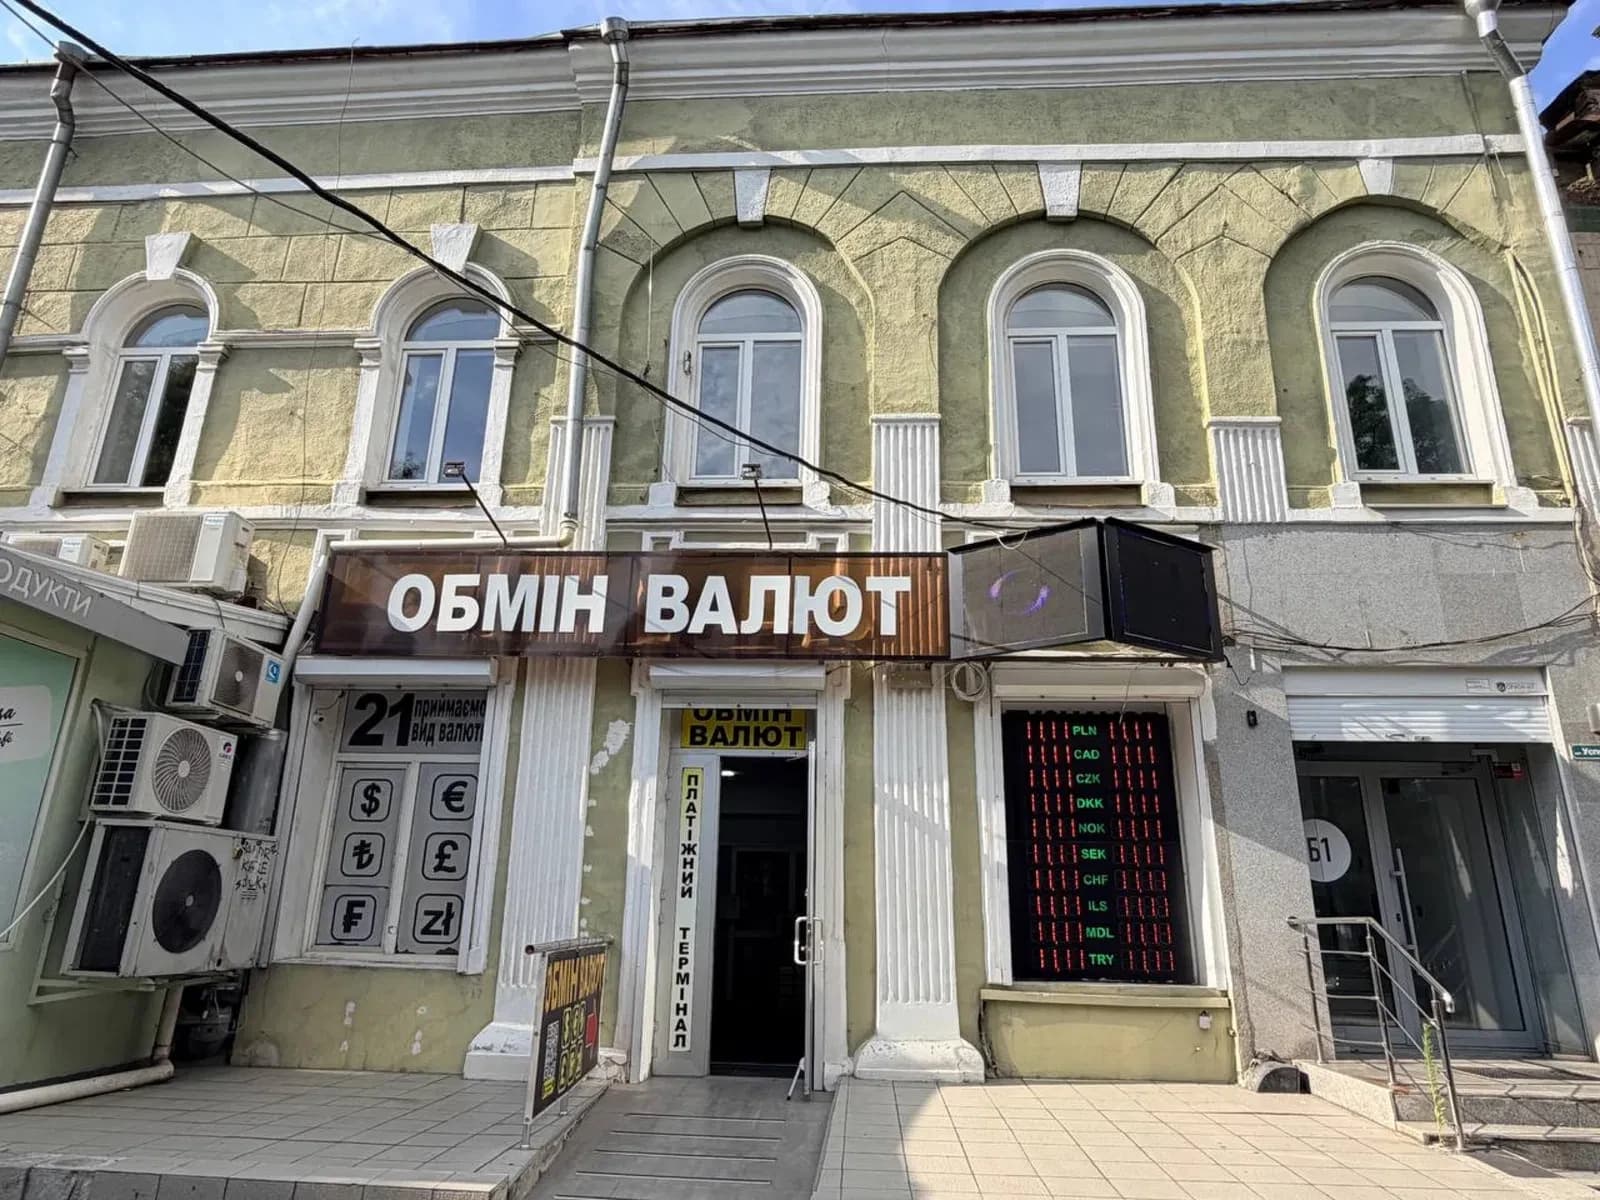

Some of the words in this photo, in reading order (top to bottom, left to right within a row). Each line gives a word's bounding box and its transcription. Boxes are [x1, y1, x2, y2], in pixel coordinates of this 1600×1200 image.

[387, 573, 609, 633] ОБМІН
[644, 574, 912, 636] ВАЛЮТ
[348, 692, 416, 747] 21
[411, 722, 436, 747] вид
[689, 724, 803, 747] ВАЛЮТ
[1073, 726, 1097, 736] PLN
[1074, 749, 1100, 760] CAD
[1076, 774, 1100, 783] CZK
[360, 782, 382, 817] $
[442, 781, 468, 813] €
[1077, 799, 1104, 808] DKK
[1078, 823, 1105, 833] NOK
[680, 773, 699, 899] ПЛАТІЖНИЙ
[433, 839, 459, 873] £
[1081, 849, 1106, 859] SEK
[1083, 875, 1108, 885] CHF
[1088, 901, 1108, 911] ILS
[1086, 927, 1114, 938] MDL
[1089, 954, 1114, 965] TRY
[673, 926, 692, 1048] ТЕРМІНАЛ
